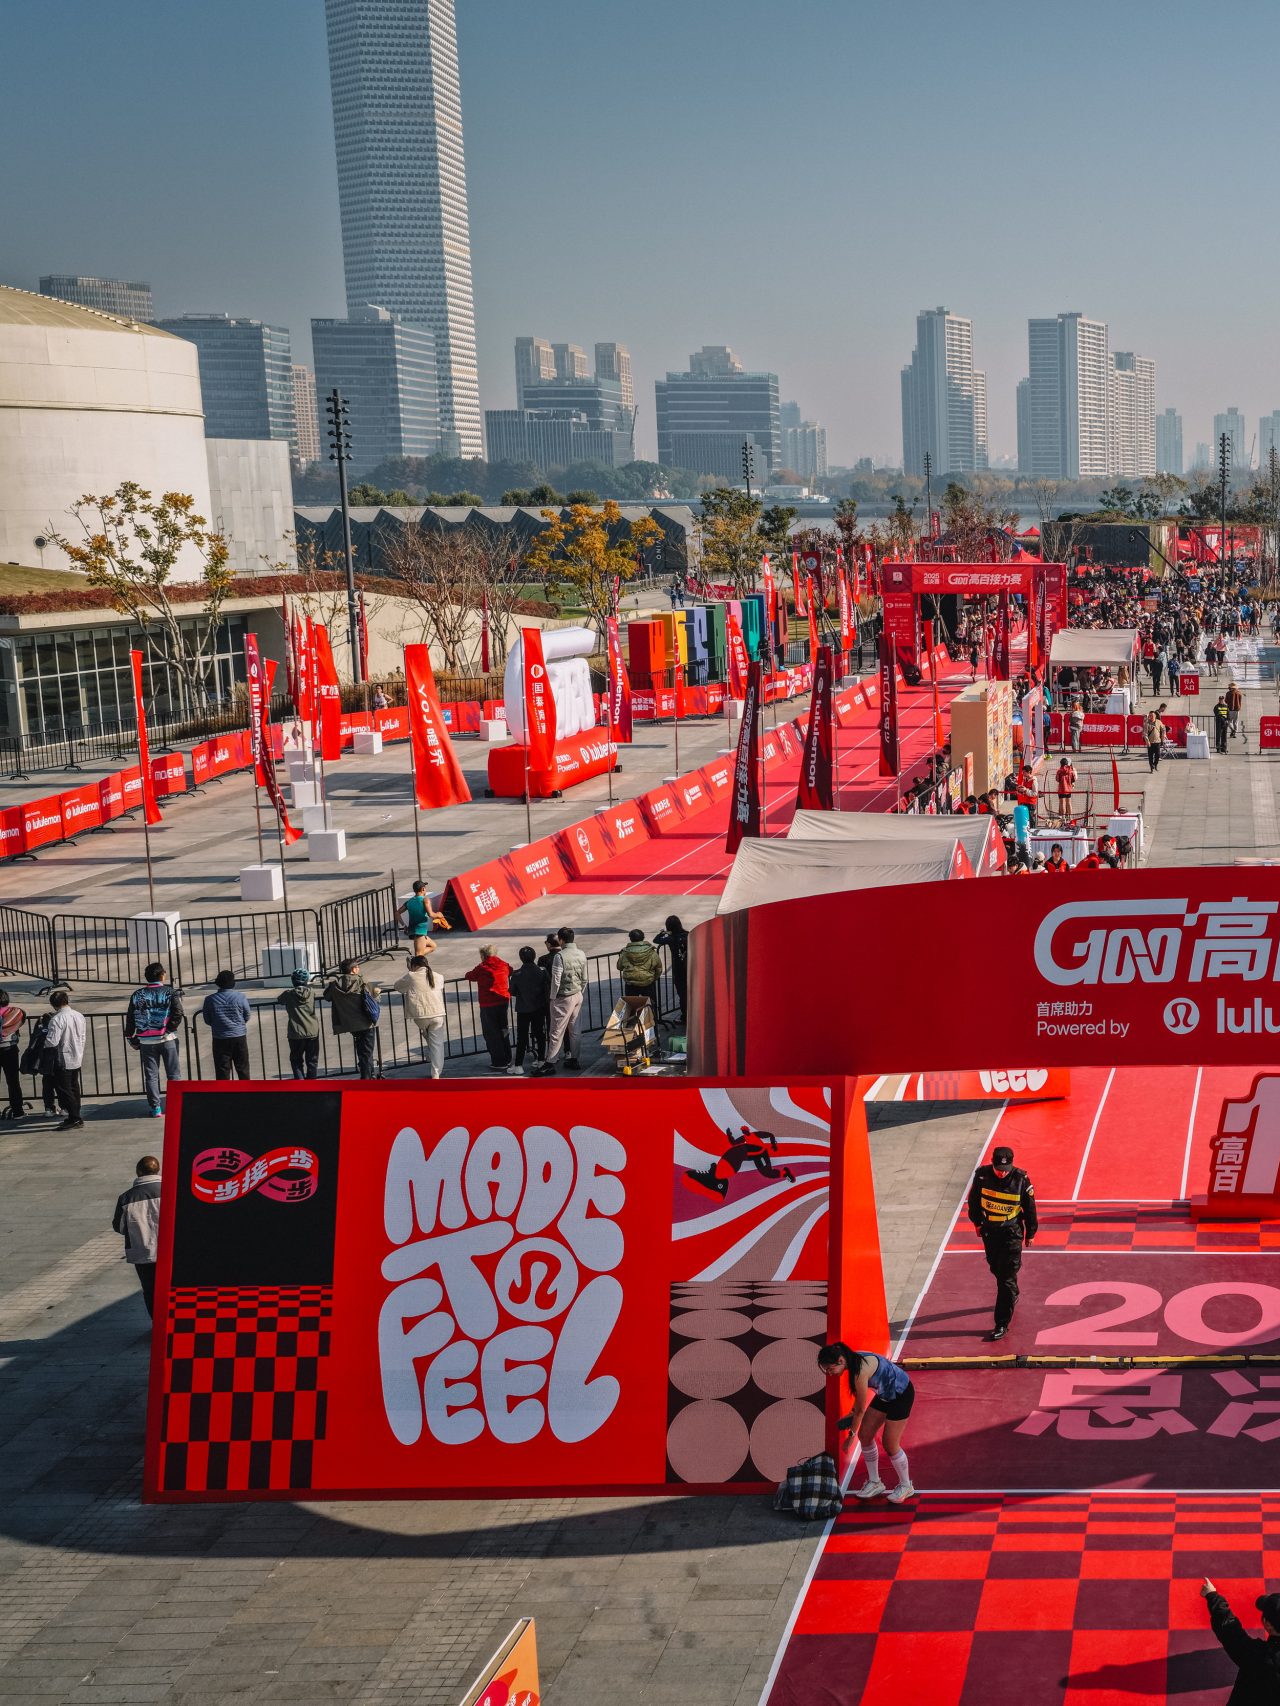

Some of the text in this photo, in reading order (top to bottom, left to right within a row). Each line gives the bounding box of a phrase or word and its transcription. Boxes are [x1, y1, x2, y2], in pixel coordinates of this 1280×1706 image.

[807, 700, 822, 788] lululemon
[32, 814, 62, 830] lululemon
[72, 802, 100, 817] lululemon
[1036, 1001, 1094, 1017] 首席助力
[1036, 1019, 1130, 1038] Powered by
[1213, 1136, 1248, 1194] 高百
[386, 1125, 627, 1272] MADE
[378, 1273, 625, 1445] FEEL
